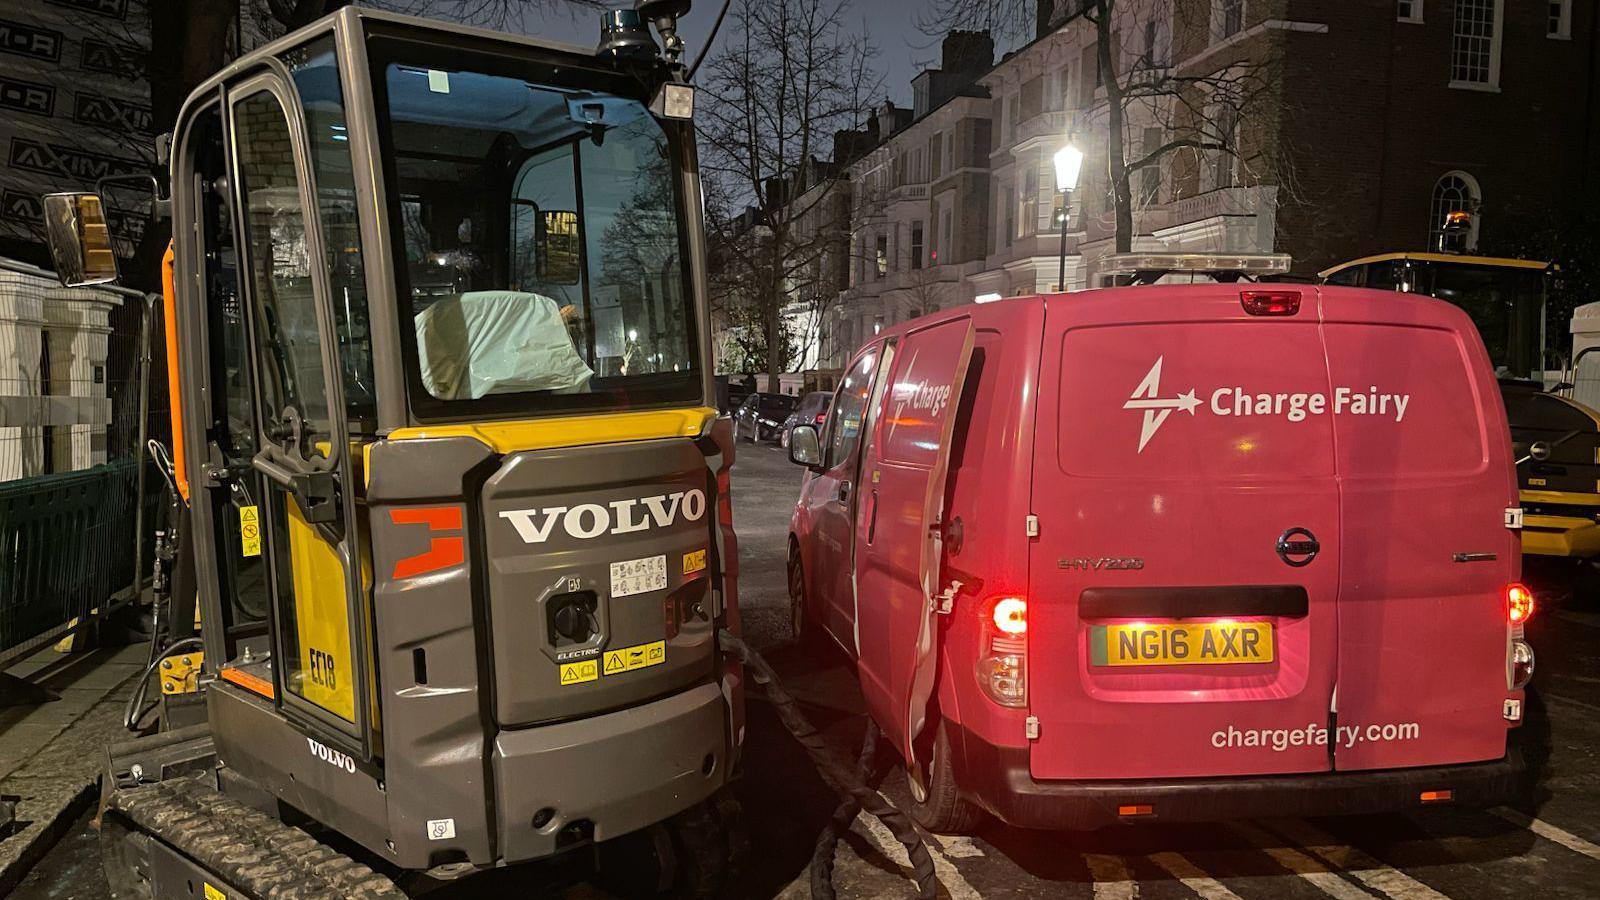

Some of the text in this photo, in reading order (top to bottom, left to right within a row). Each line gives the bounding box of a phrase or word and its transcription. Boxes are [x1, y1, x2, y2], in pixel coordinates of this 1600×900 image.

[912, 379, 951, 417] Charge
[1210, 386, 1410, 422] Charge Fairy
[499, 488, 706, 544] VOLVO
[557, 648, 600, 660] ELECTRIC
[1119, 628, 1260, 660] NG16 AXR
[309, 647, 337, 691] EC18
[1211, 720, 1420, 752] chargefary.com
[306, 737, 357, 775] VOLVO
